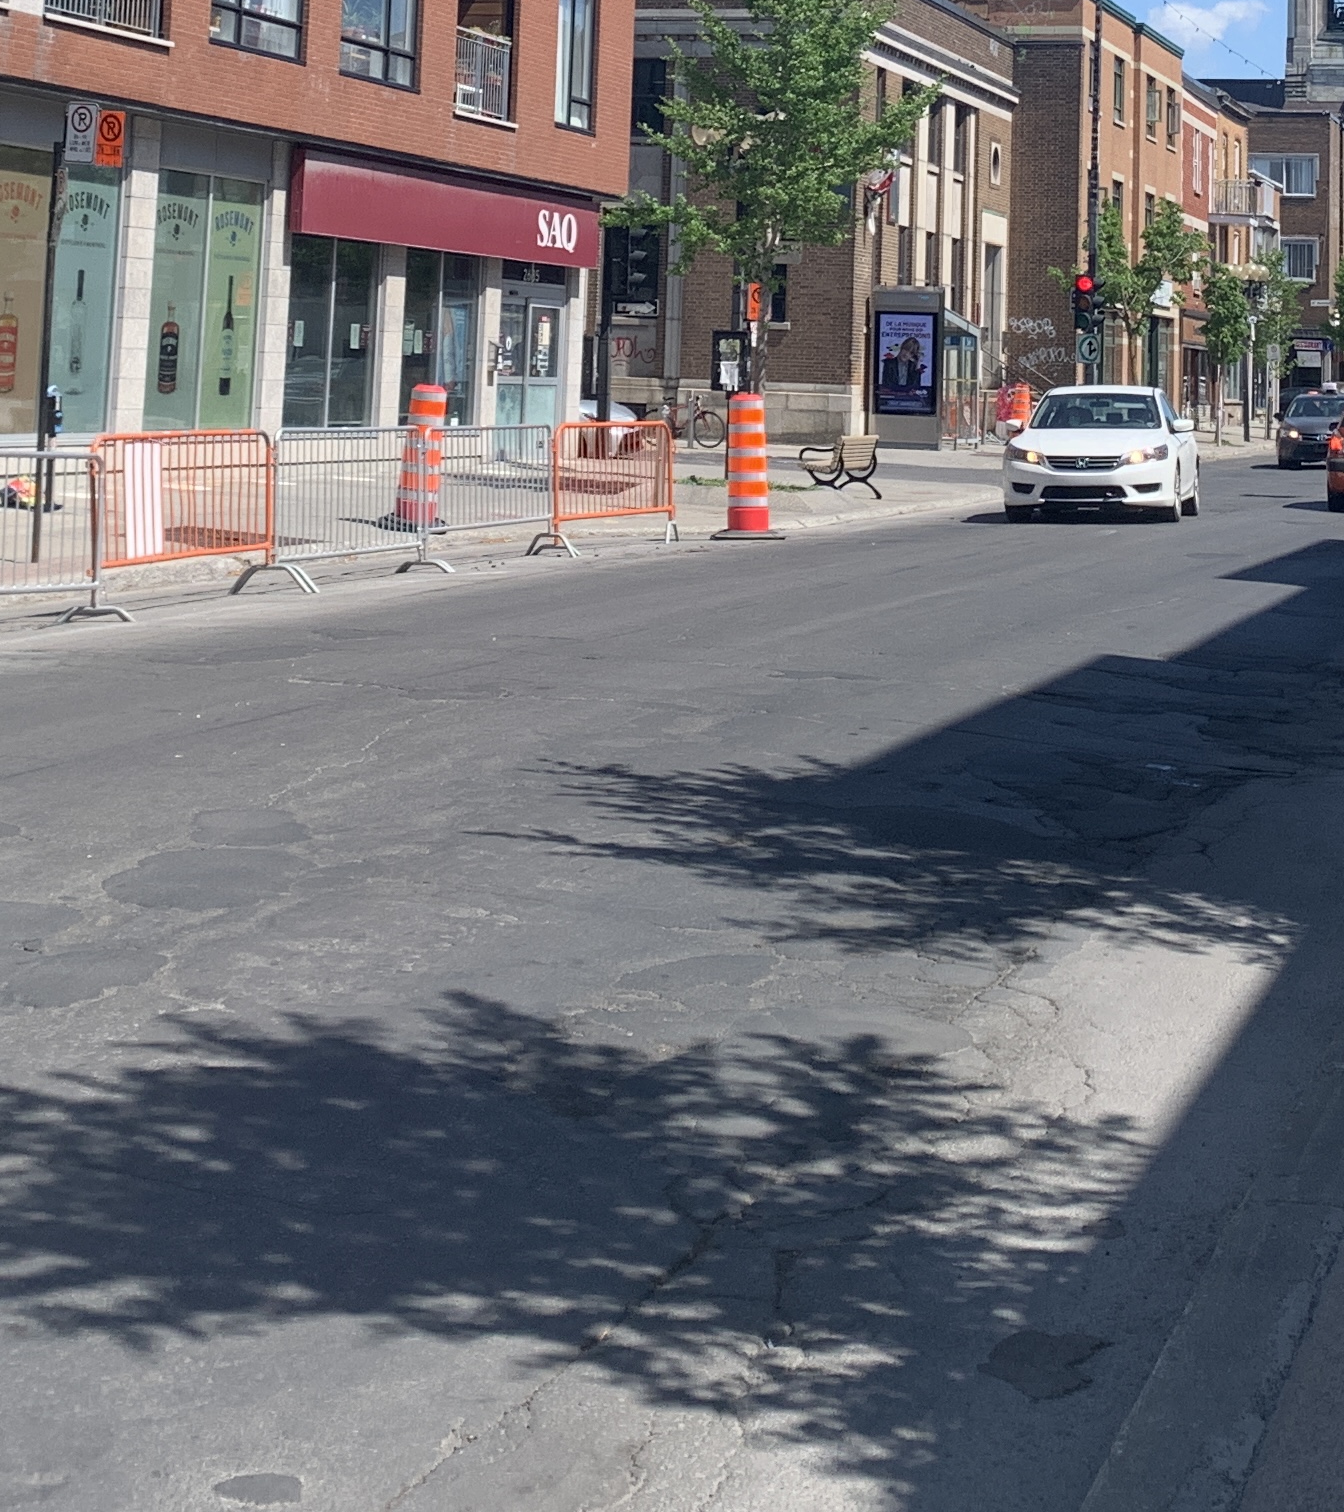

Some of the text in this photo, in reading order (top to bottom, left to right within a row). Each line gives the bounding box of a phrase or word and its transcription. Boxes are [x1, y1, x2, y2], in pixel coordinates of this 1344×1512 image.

[68, 191, 111, 220] OSEMONT
[215, 210, 255, 236] ROSEMONT
[536, 209, 577, 253] SAQ
